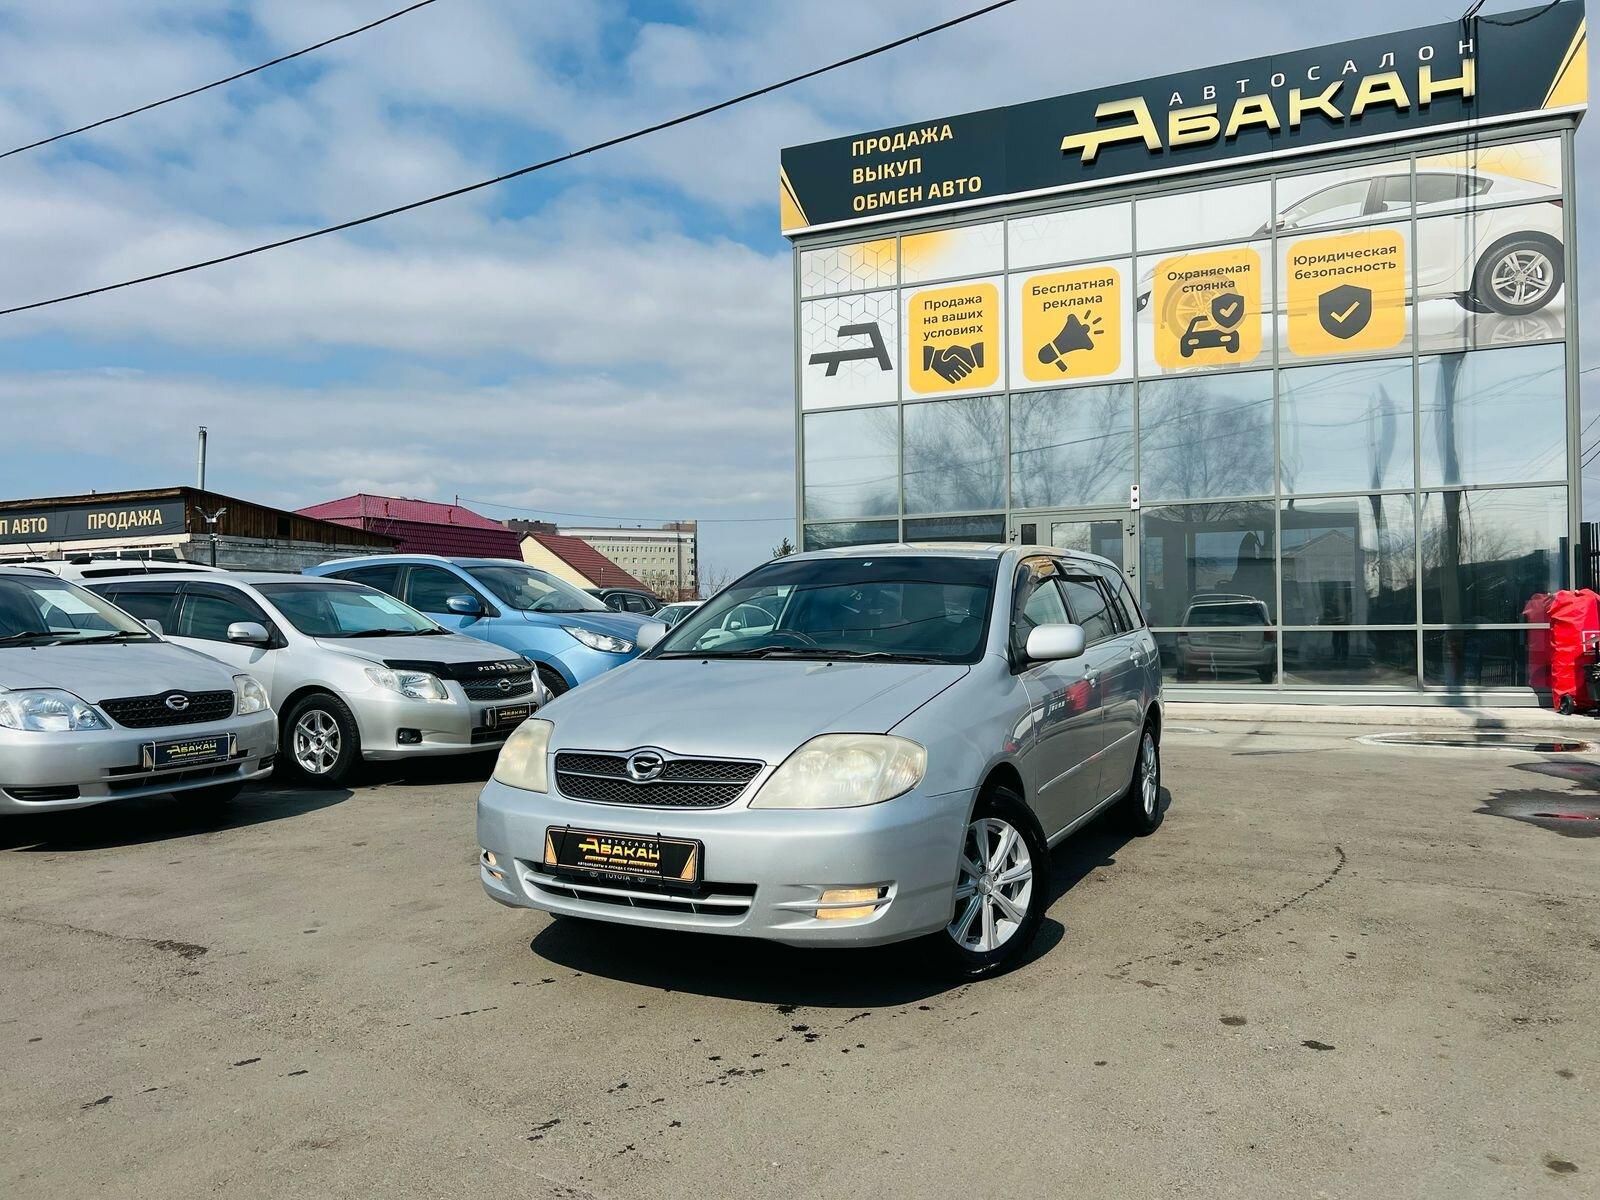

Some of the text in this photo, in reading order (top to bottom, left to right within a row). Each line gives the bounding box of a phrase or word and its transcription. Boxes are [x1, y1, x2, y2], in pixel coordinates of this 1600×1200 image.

[1168, 39, 1475, 105] АВТОСАЛОН
[1060, 57, 1477, 163] АБАКАН
[852, 124, 954, 157] ПРОДАЖА
[852, 158, 922, 184] ВЫКУП
[853, 176, 982, 212] ОБМЕН АВТО
[1293, 245, 1397, 266] Юридическая
[1167, 264, 1251, 282] Охраняемая
[1294, 261, 1397, 280] безопасность
[1032, 278, 1115, 297] Бесплатная
[1182, 280, 1236, 294] стоянка
[924, 294, 982, 311] Продажа
[1043, 294, 1103, 312] реклама
[923, 310, 984, 325] на ваших
[923, 324, 984, 341] условиях
[12, 517, 48, 534] АВТО
[88, 509, 163, 530] ПРОДАЖА
[578, 838, 660, 860] АБАКАН
